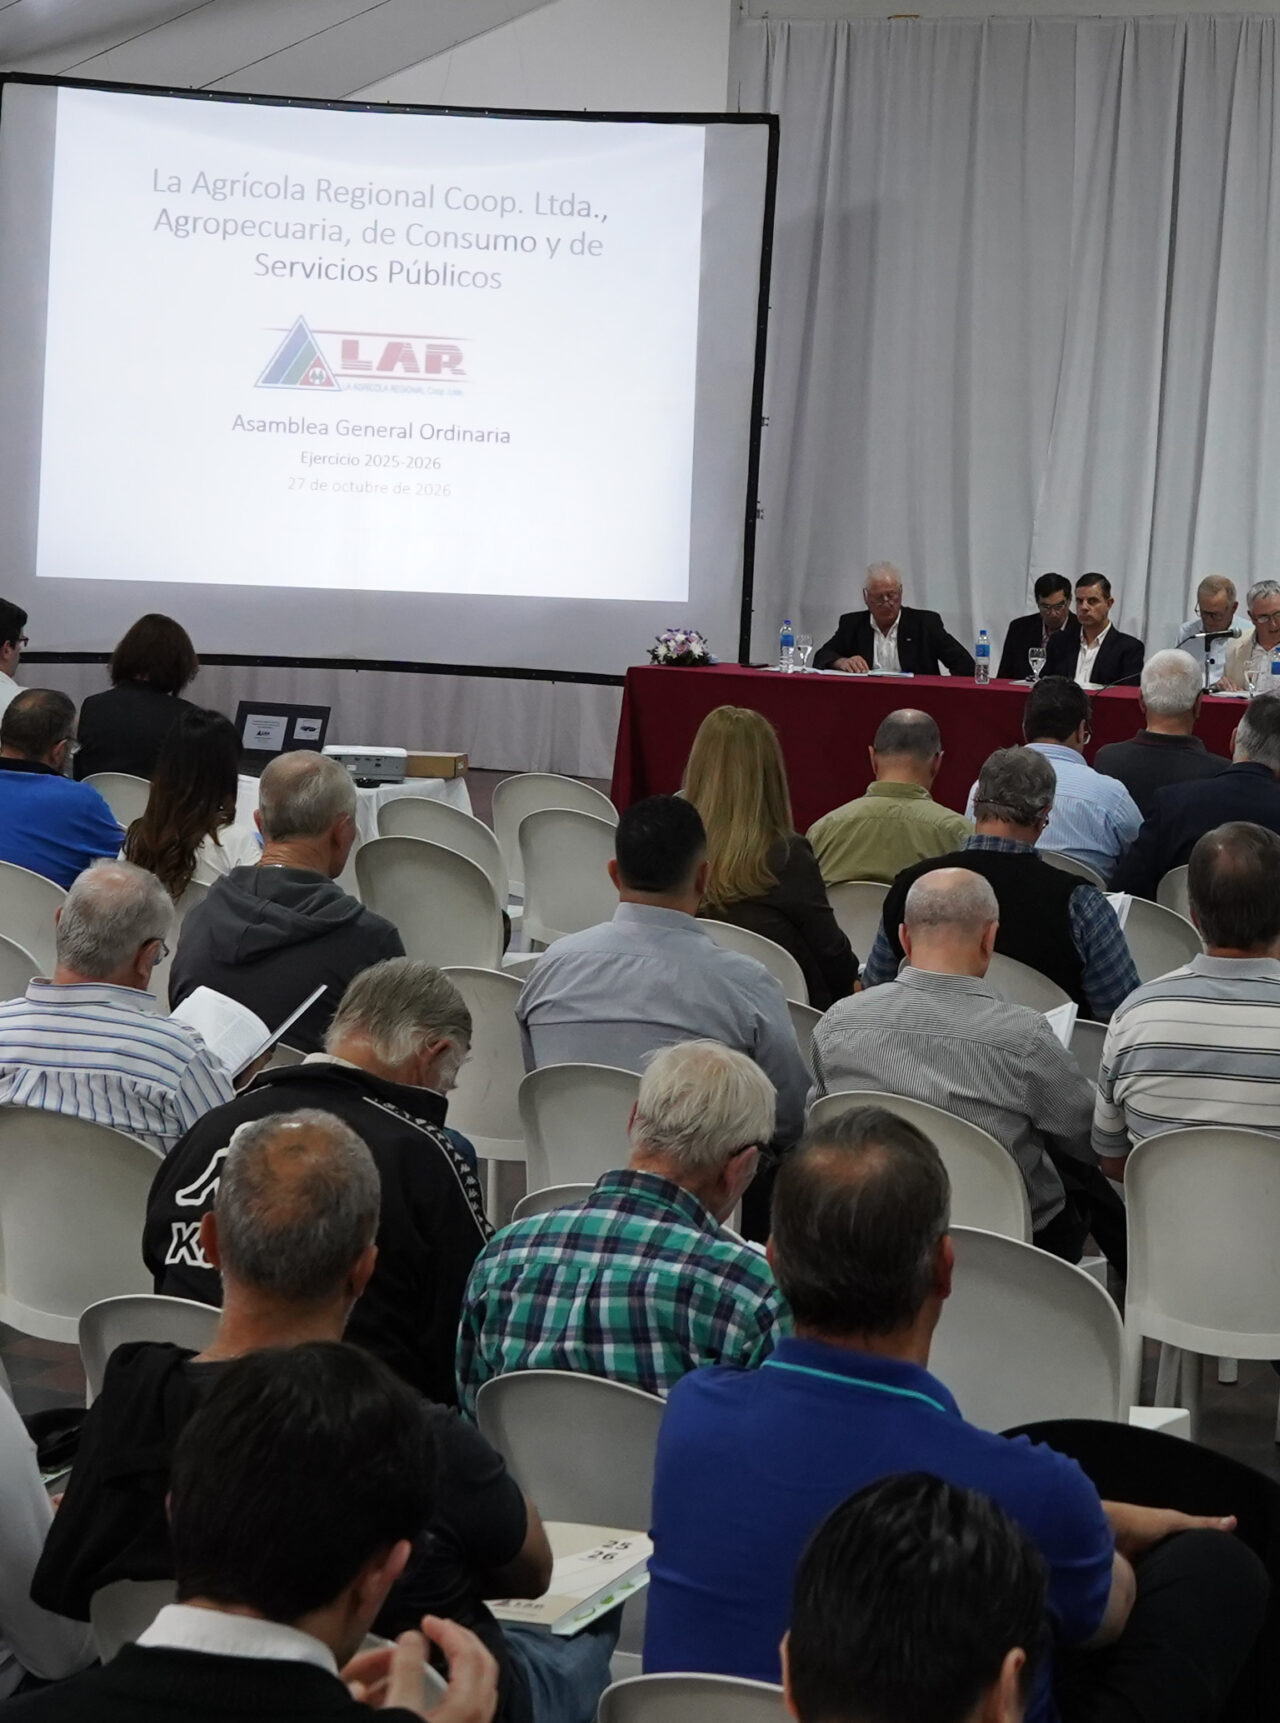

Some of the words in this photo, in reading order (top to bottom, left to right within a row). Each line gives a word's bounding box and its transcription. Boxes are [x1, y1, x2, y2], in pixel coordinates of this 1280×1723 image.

[152, 168, 182, 194] La
[191, 170, 306, 202] Agrícola
[316, 178, 434, 210] Regional
[444, 185, 523, 219] Coop.
[535, 191, 608, 223] Ltda.,
[153, 208, 352, 246] Agropecuaria,
[362, 218, 396, 246] de
[405, 222, 537, 254] Consumo
[545, 236, 562, 258] y
[569, 231, 604, 257] de
[254, 252, 378, 284] Servicios
[389, 259, 503, 290] Públicos
[341, 338, 468, 376] LAR
[232, 414, 329, 436] Asamblea
[336, 419, 412, 440] General
[420, 423, 511, 444] Ordinaria
[301, 450, 360, 468] Ejercicio
[364, 453, 442, 470] 2025-2026
[310, 478, 328, 492] de
[332, 480, 389, 495] octubre
